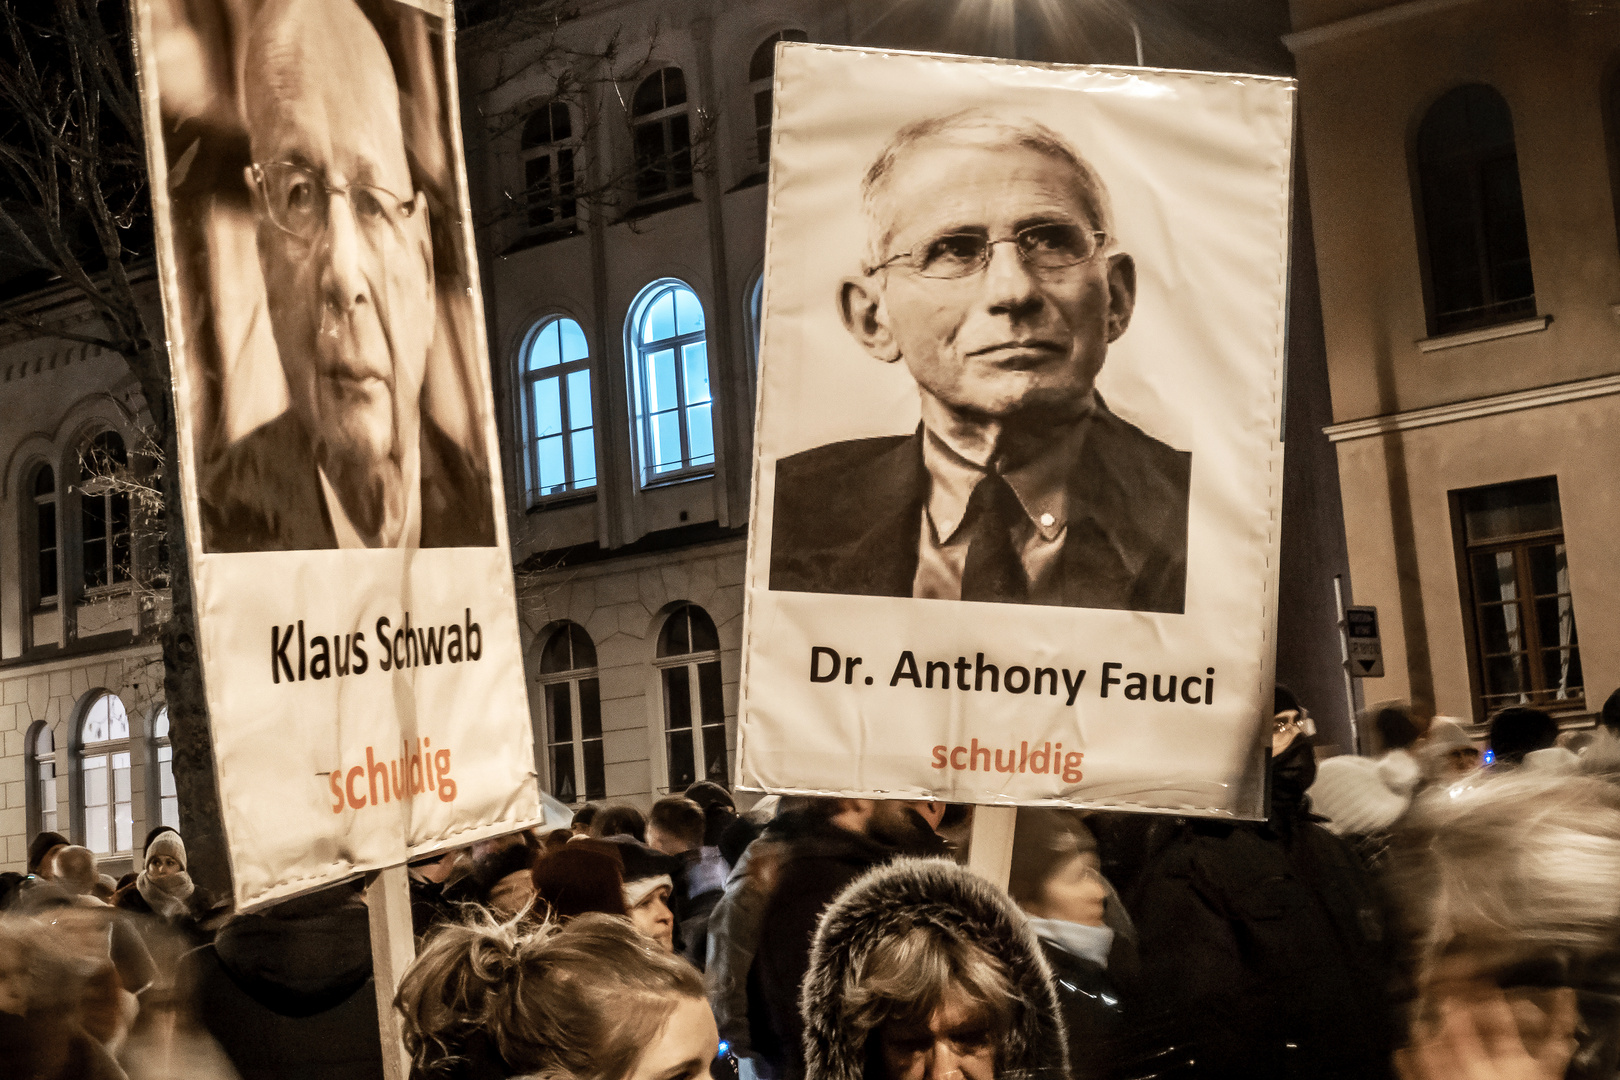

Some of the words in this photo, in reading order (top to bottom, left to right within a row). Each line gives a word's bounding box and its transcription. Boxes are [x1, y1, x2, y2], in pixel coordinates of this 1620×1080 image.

[271, 620, 369, 684] Klaus
[375, 607, 482, 672] Schwab
[809, 646, 875, 686] Dr.
[889, 650, 1087, 707] Anthony
[1100, 661, 1215, 705] Fauci
[328, 737, 458, 814] schuldig
[931, 737, 1086, 784] schuldig
